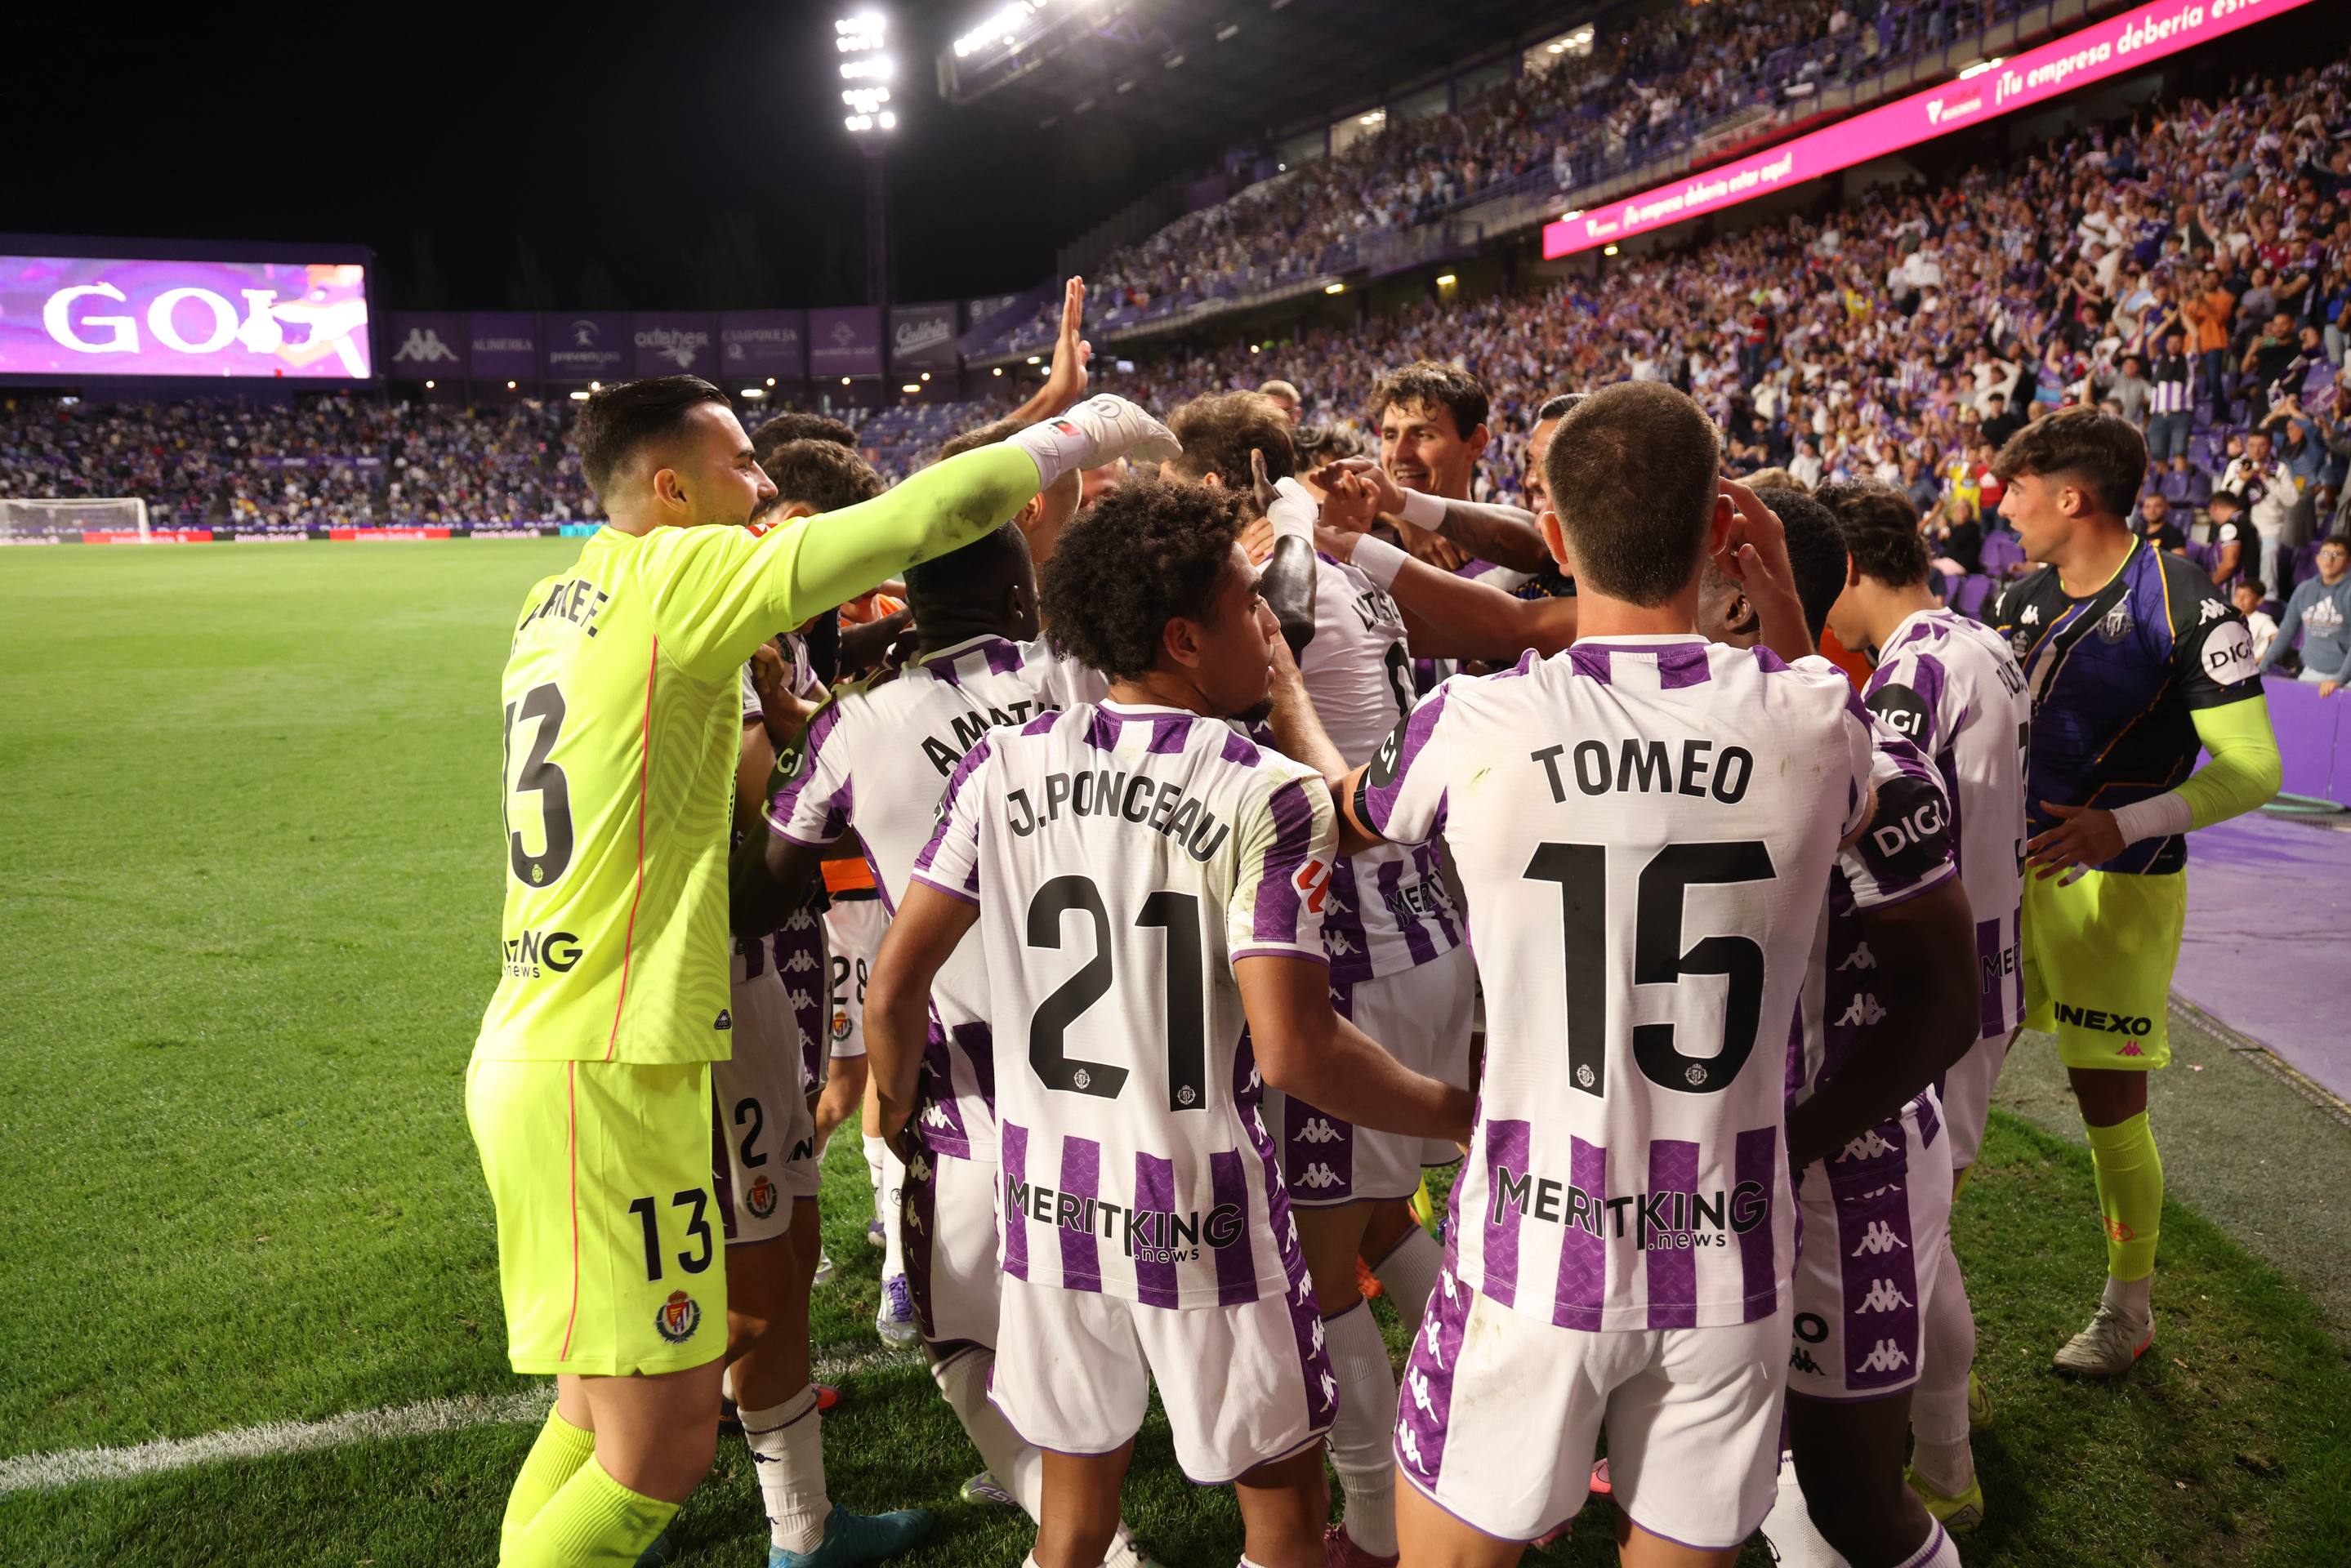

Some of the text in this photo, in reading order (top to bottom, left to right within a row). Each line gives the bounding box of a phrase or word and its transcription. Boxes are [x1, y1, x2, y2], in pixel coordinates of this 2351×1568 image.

[1996, 70, 2023, 105] ¡Tu
[2027, 41, 2111, 83] empresa
[2117, 5, 2204, 55] debería
[43, 282, 315, 354] GOL
[921, 700, 1060, 777] AMAT
[1531, 738, 1754, 804] TOMEO
[1007, 770, 1230, 862] J.PONCEAU
[1872, 800, 1946, 858] DIGI
[1027, 875, 1207, 1112] 21
[1522, 840, 1778, 1098] 15
[736, 1098, 768, 1169] 2
[628, 1188, 712, 1281] 13
[1007, 1174, 1244, 1258] MERITKING
[1493, 1166, 1768, 1250] MERITKING
